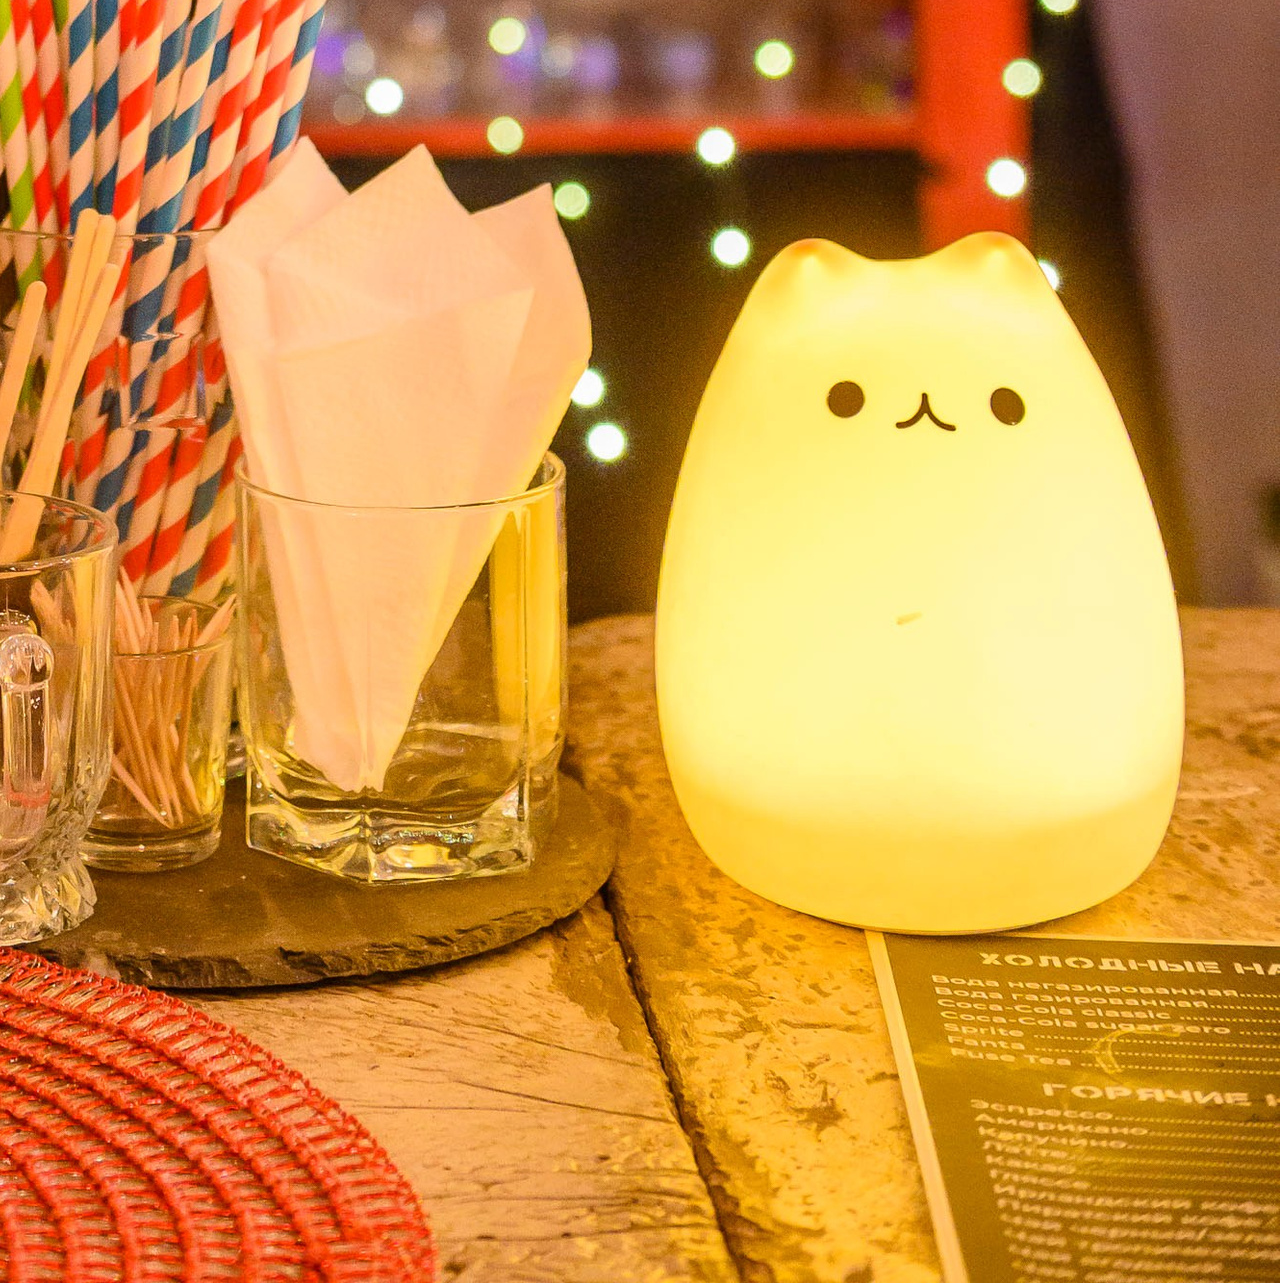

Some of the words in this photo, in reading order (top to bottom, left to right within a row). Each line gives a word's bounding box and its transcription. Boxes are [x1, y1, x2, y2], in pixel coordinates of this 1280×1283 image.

[979, 952, 1222, 974] ХОЛОДНЫЕ
[931, 974, 1000, 987] Вода
[1007, 981, 1239, 998] негазированная
[934, 986, 1004, 1000] Вода
[1011, 993, 1209, 1009] газированная
[937, 998, 1074, 1016] Coca-Cola
[1081, 1008, 1171, 1020] classic
[940, 1010, 1078, 1028] Coca-Cola
[1085, 1020, 1163, 1033] sugar
[1170, 1023, 1231, 1035] zero
[943, 1022, 1025, 1038] Sprite
[947, 1034, 1026, 1051] Fanta
[950, 1047, 1016, 1063] Fuse
[1022, 1053, 1072, 1067] Tea
[1042, 1083, 1253, 1107] ГОРЯЧИЕ
[970, 1098, 1114, 1120] Эспрессо
[974, 1112, 1149, 1136] Американо
[978, 1125, 1128, 1149] Капучино
